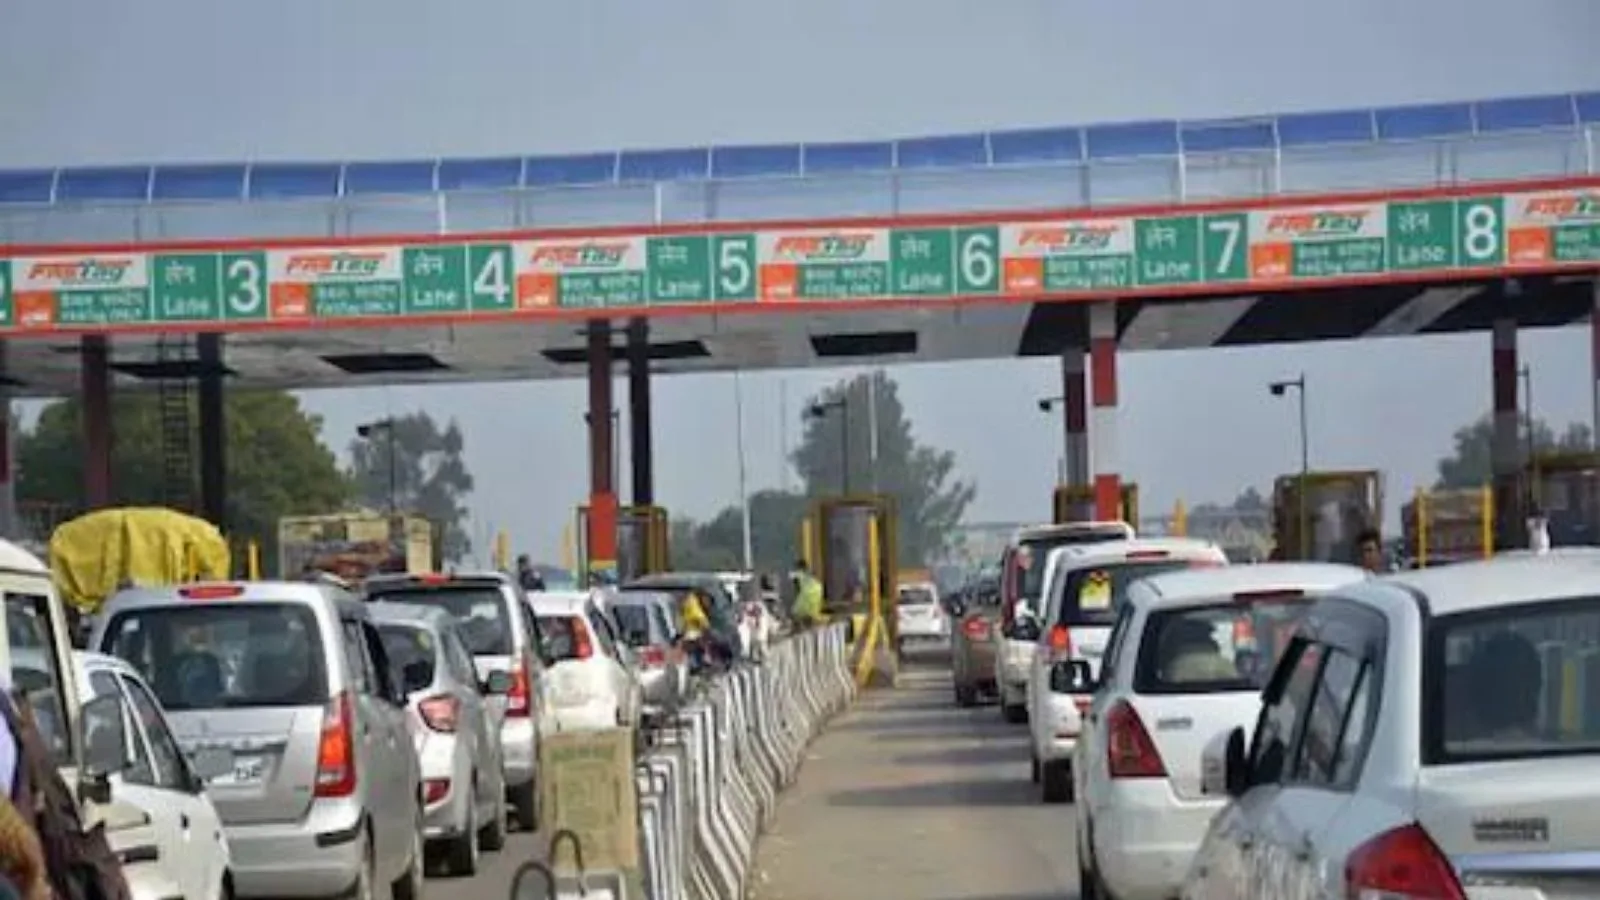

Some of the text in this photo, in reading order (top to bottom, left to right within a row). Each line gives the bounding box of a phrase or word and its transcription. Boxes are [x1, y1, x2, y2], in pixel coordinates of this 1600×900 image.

[1209, 221, 1240, 273] 7
[1464, 204, 1497, 258] 8
[721, 240, 750, 293] 5
[963, 233, 993, 286] 6
[1143, 261, 1191, 279] Lane
[1397, 245, 1445, 264] Lane
[229, 259, 261, 312] 3
[473, 251, 510, 303] 4
[657, 279, 702, 297] Lane
[900, 271, 944, 290] Lane
[163, 298, 209, 316] Lane
[413, 289, 458, 307] Lane
